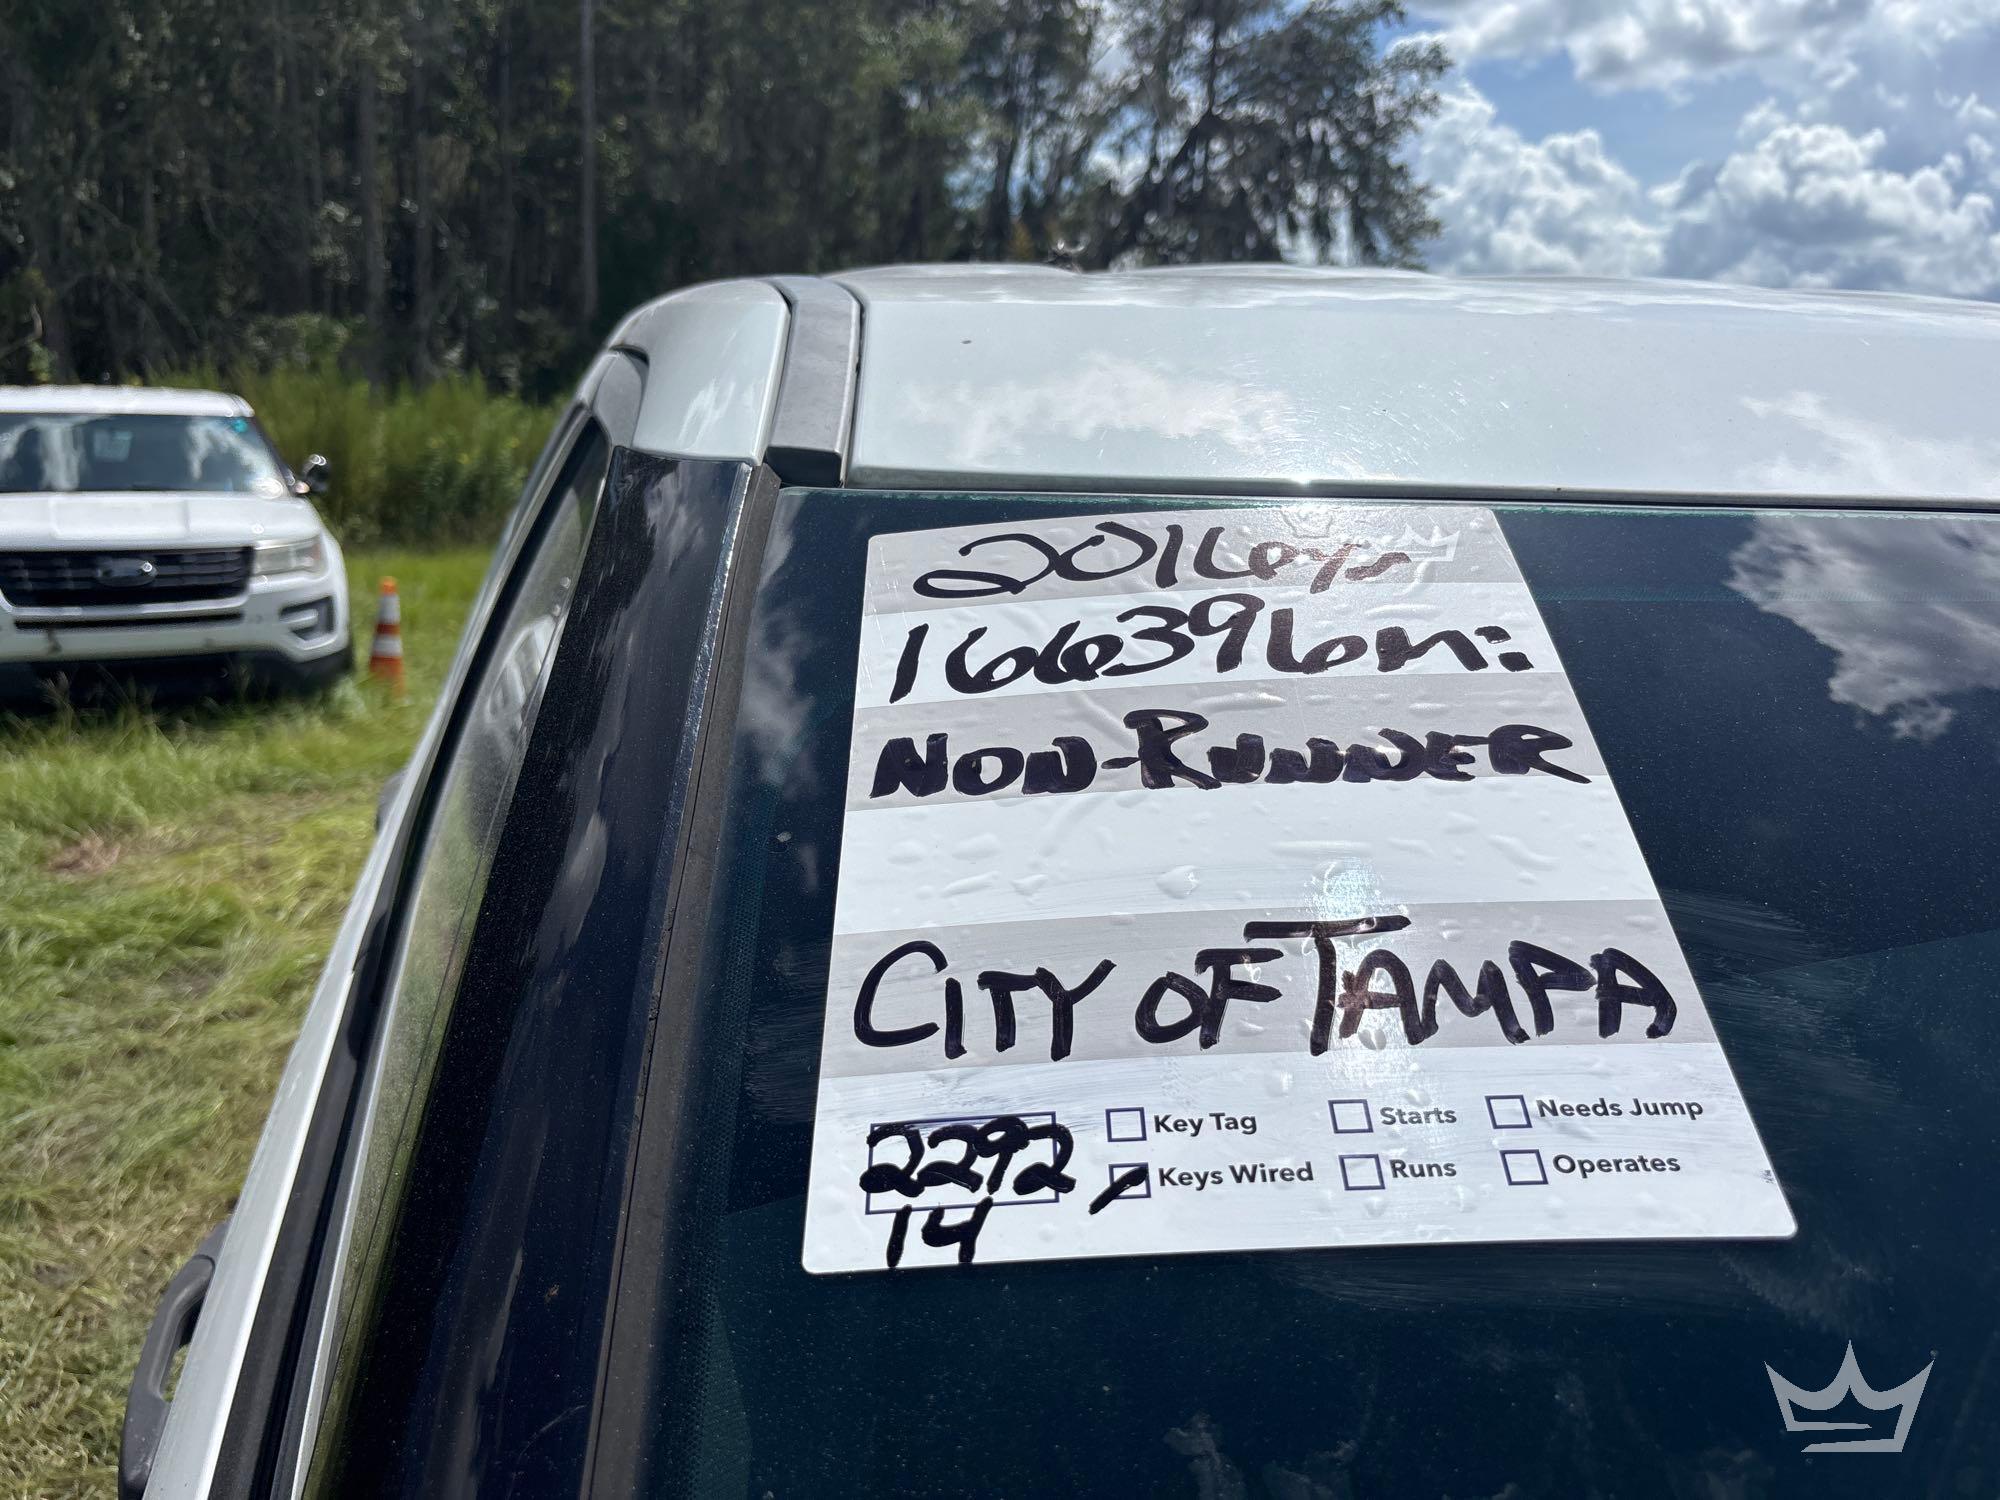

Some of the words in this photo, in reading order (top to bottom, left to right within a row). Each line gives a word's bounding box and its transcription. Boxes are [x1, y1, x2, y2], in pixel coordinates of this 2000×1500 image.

[1380, 1105, 1457, 1126] Starts
[1538, 1098, 1623, 1119] Needs
[1629, 1097, 1704, 1121] Jump
[1154, 1113, 1204, 1136] Key
[1210, 1112, 1257, 1135] Tag
[860, 1115, 1077, 1198] 2292
[1552, 1154, 1682, 1179] Operates
[1158, 1166, 1224, 1190] Keys
[1229, 1161, 1315, 1184] Wired
[1390, 1159, 1458, 1179] Runs
